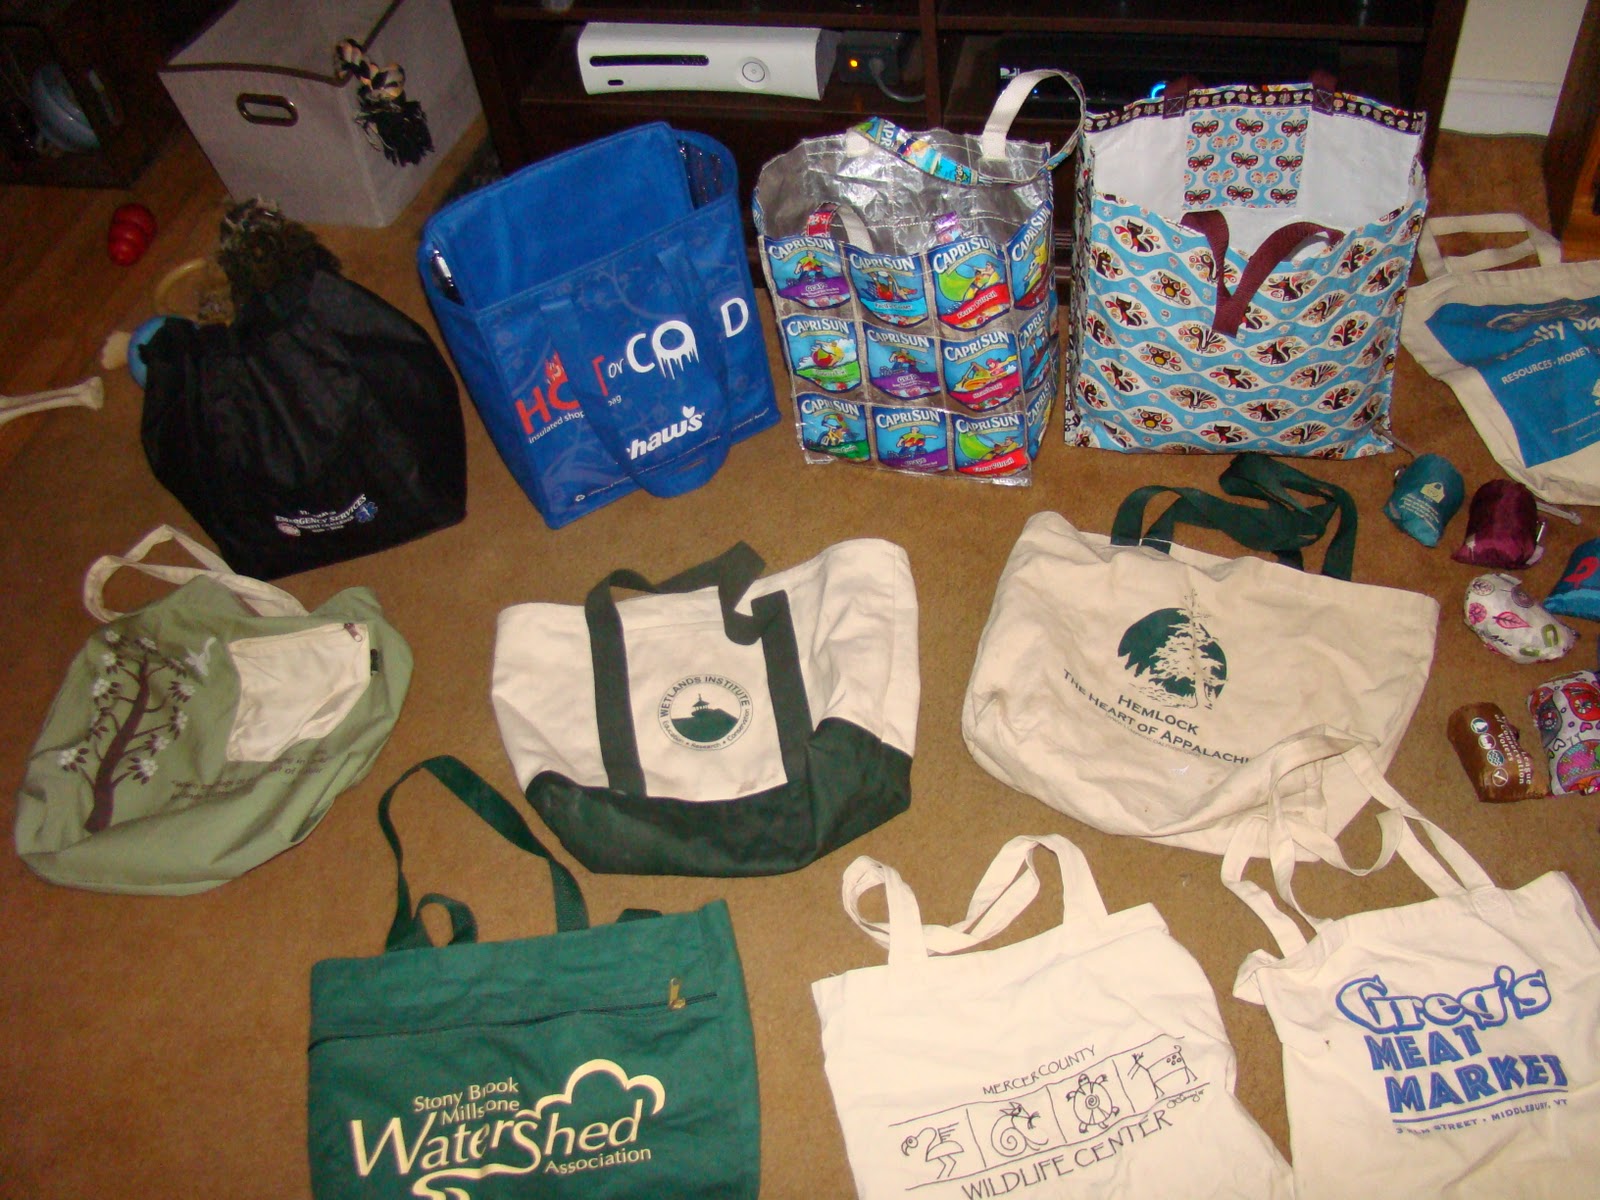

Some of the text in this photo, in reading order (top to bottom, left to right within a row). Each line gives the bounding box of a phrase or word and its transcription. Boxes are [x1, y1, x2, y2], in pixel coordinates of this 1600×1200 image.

[608, 358, 624, 378] or
[1501, 346, 1591, 385] RESOURCES MONEY
[529, 416, 563, 444] insulated
[660, 676, 750, 718] WETLANDS INSTITUTE
[1063, 668, 1086, 695] THE
[1088, 693, 1136, 726] HEART
[1137, 723, 1158, 735] OF
[1118, 694, 1199, 735] HEMLOCK
[1335, 965, 1552, 1035] Greg's
[1363, 1024, 1482, 1071] MEAT
[982, 1044, 1096, 1095] MERCER COUNTY
[1384, 1054, 1569, 1113] MARKET
[414, 1092, 463, 1112] Stony
[1433, 1118, 1479, 1132] STREET
[545, 1147, 652, 1175] Association
[961, 1109, 1174, 1200] WILDLIFE CENTER
